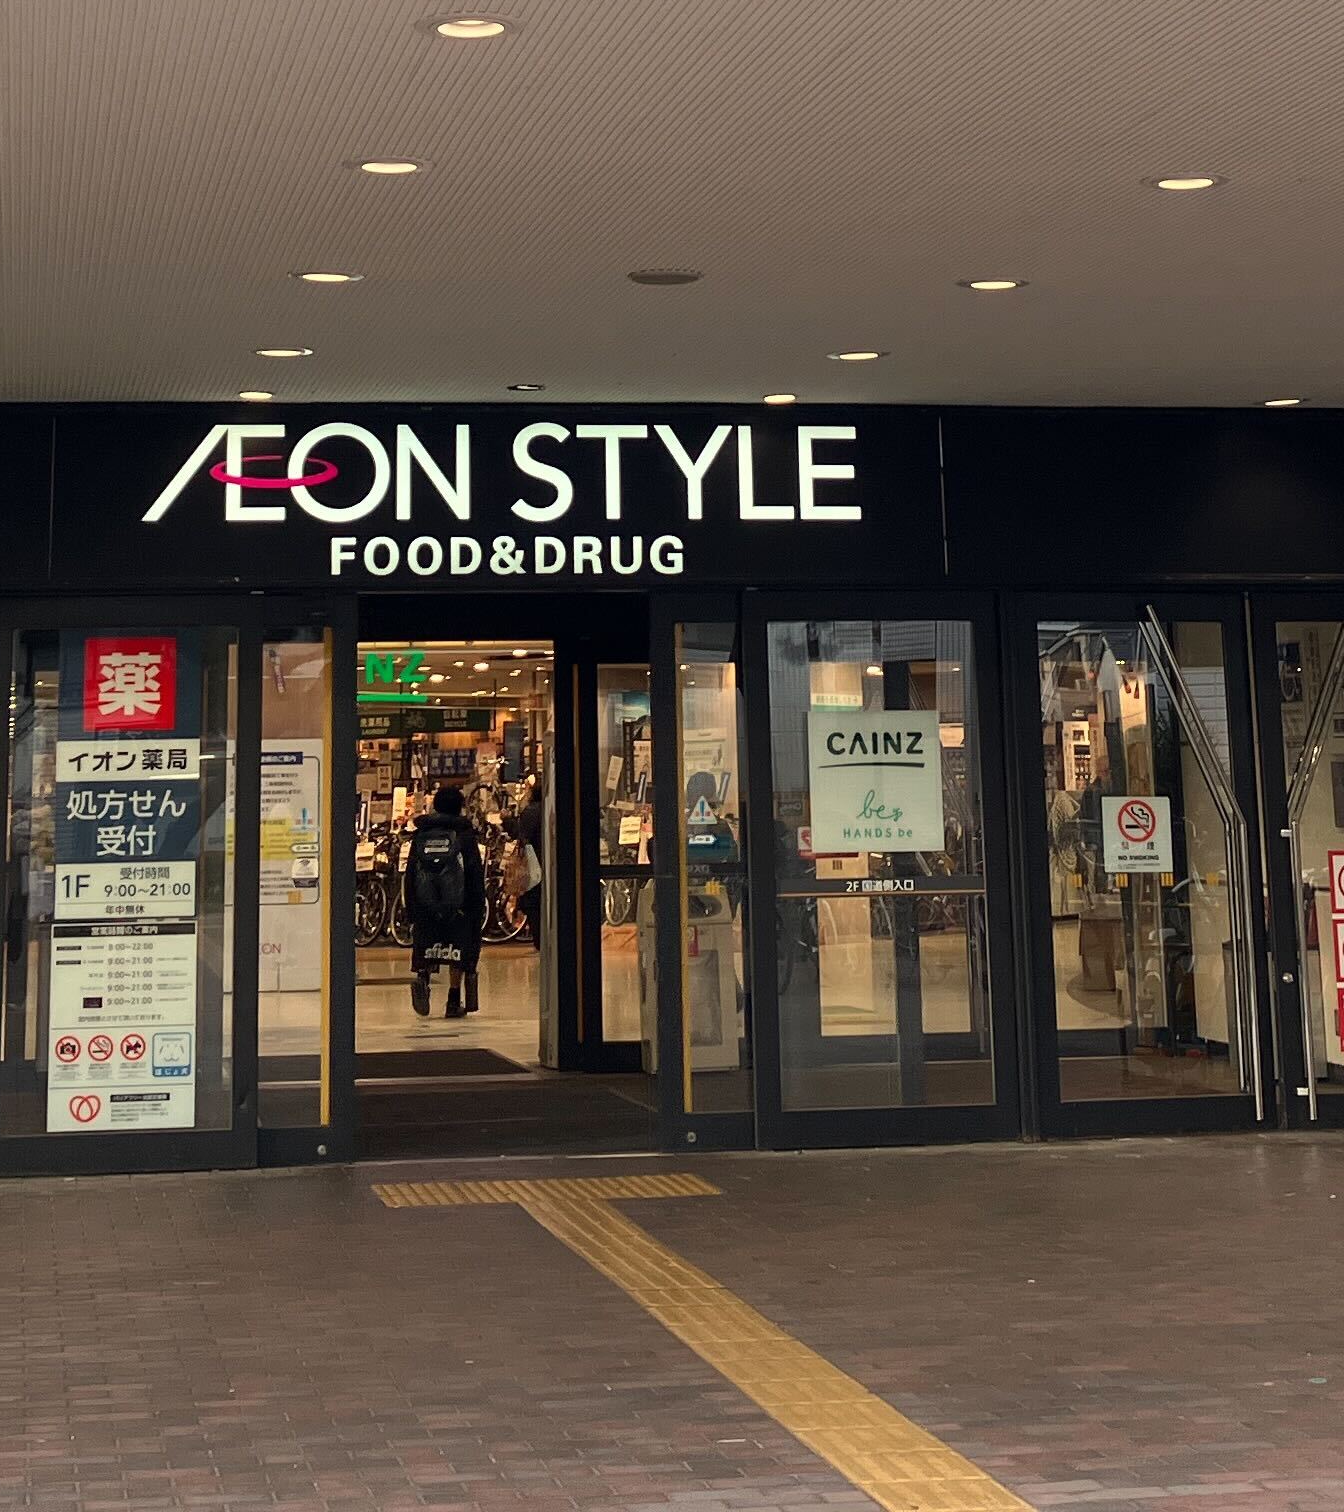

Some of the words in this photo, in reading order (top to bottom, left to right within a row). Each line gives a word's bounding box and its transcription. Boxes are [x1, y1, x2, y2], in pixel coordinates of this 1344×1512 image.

[511, 422, 863, 522] STYLE
[330, 535, 685, 576] FOOD&DRUG
[97, 652, 162, 717] 薬
[826, 730, 924, 756] CAINZ
[67, 748, 189, 772] イオン薬局
[66, 789, 187, 821] 処方せん
[96, 825, 157, 857] 受付
[843, 828, 892, 839] HANDS
[897, 828, 913, 838] be
[61, 874, 91, 899] 1F
[119, 867, 171, 880] 受付時間
[105, 905, 145, 915] 年中無休
